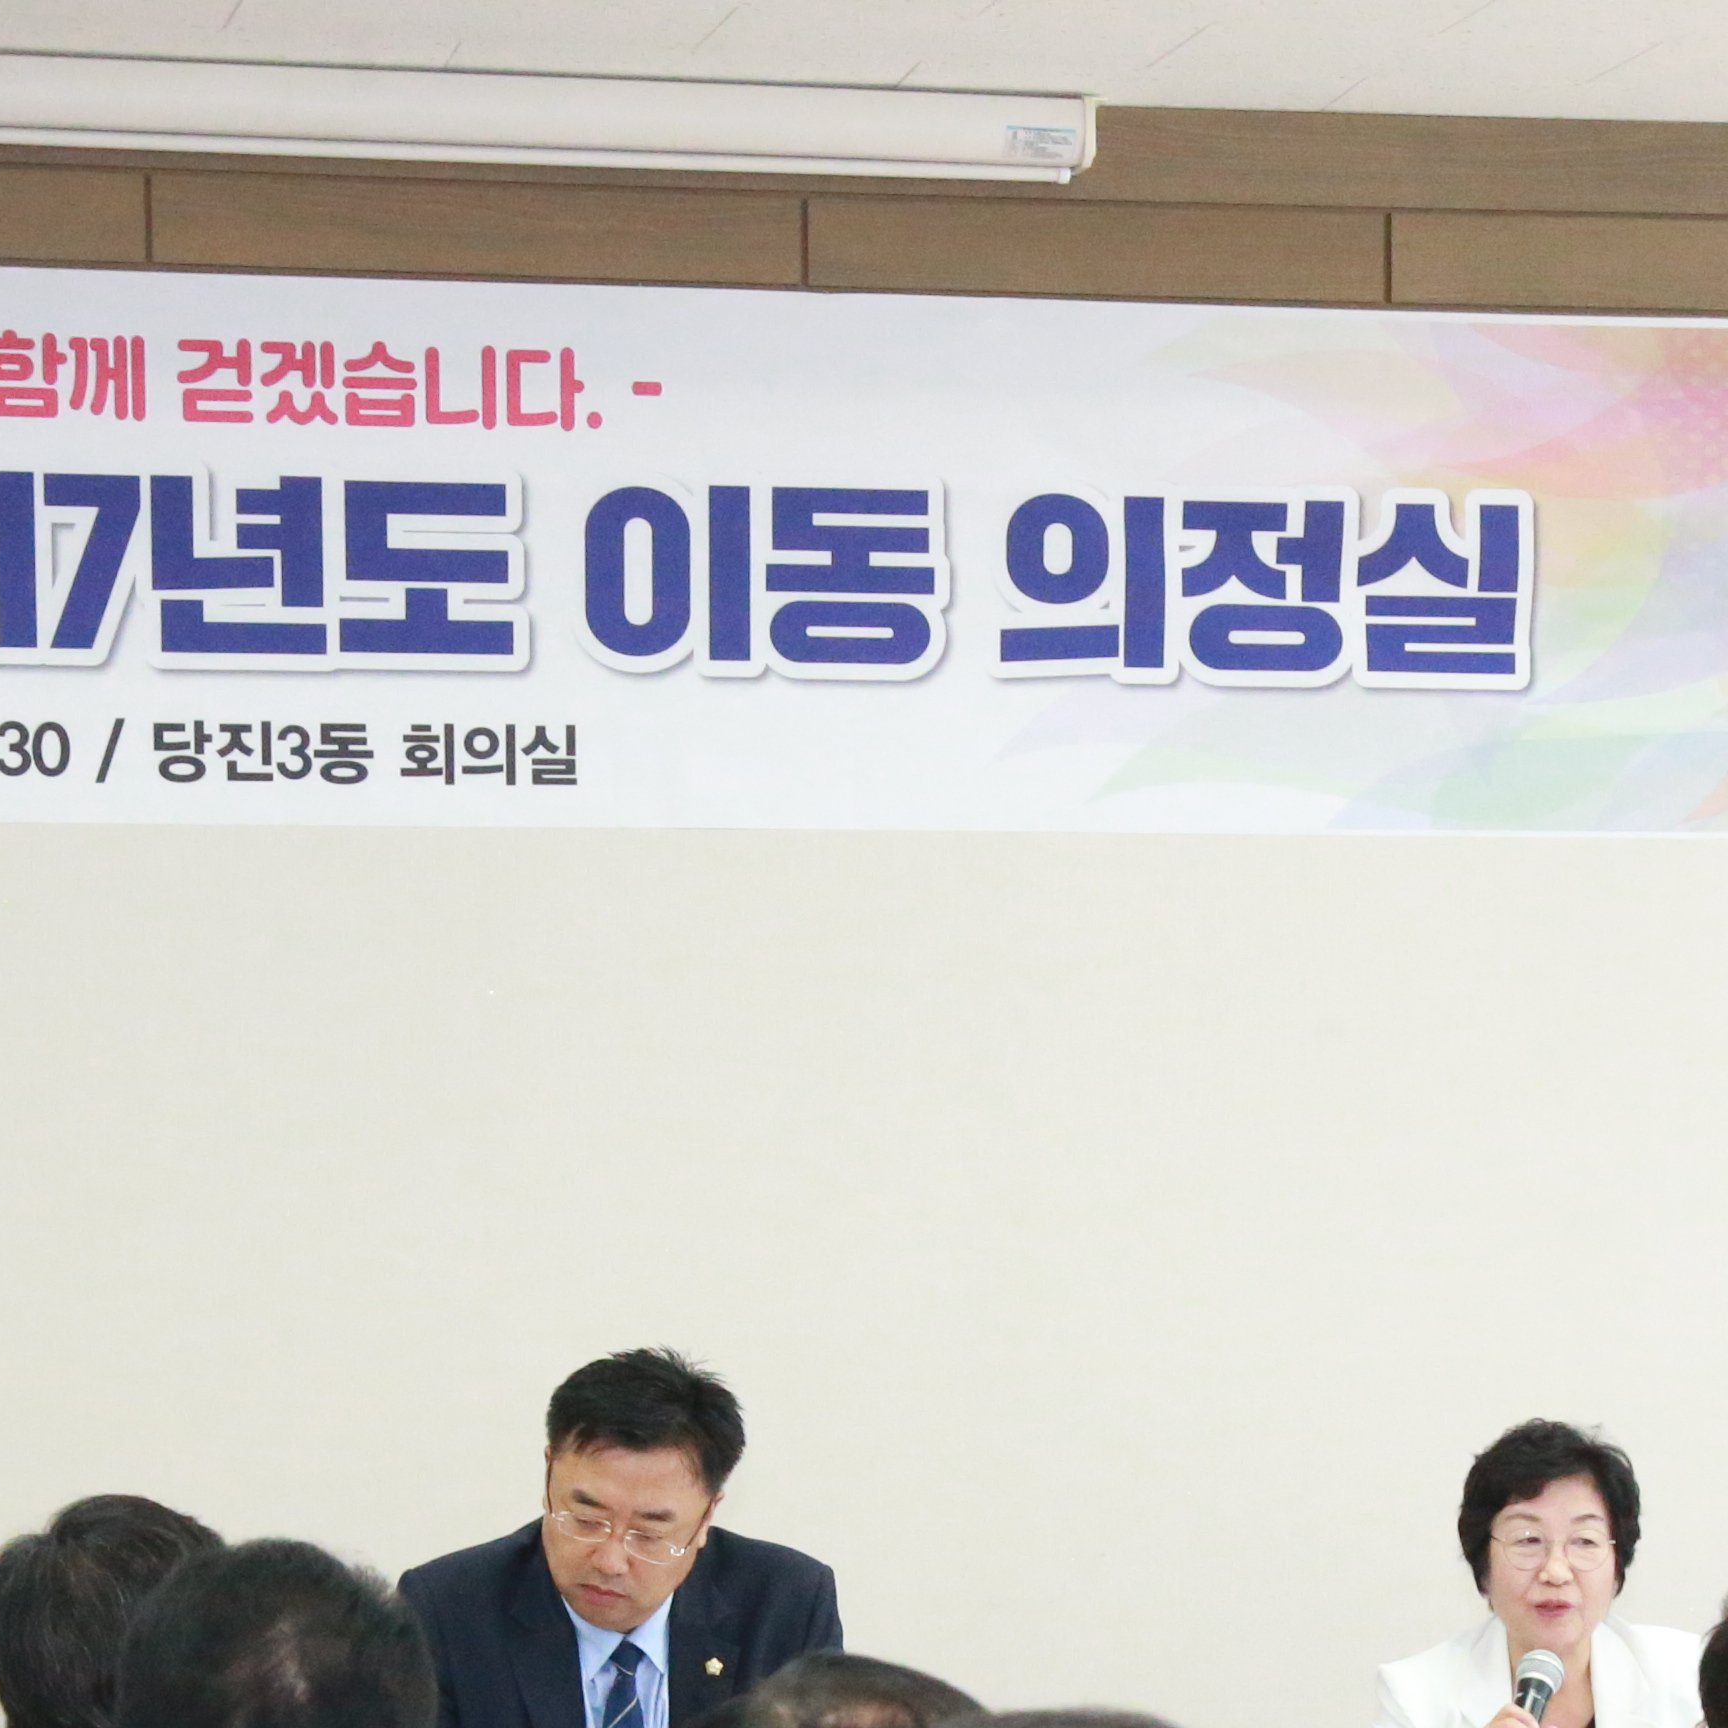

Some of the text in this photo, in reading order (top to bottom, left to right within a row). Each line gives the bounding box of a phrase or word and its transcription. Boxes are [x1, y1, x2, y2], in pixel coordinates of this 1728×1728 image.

[177, 338, 603, 432] 걷겠습니다.
[584, 485, 936, 665] 이동
[1000, 493, 1520, 675] 의정실
[94, 717, 126, 784] /
[152, 719, 375, 786] 당진3동
[399, 722, 578, 787] 회의실
